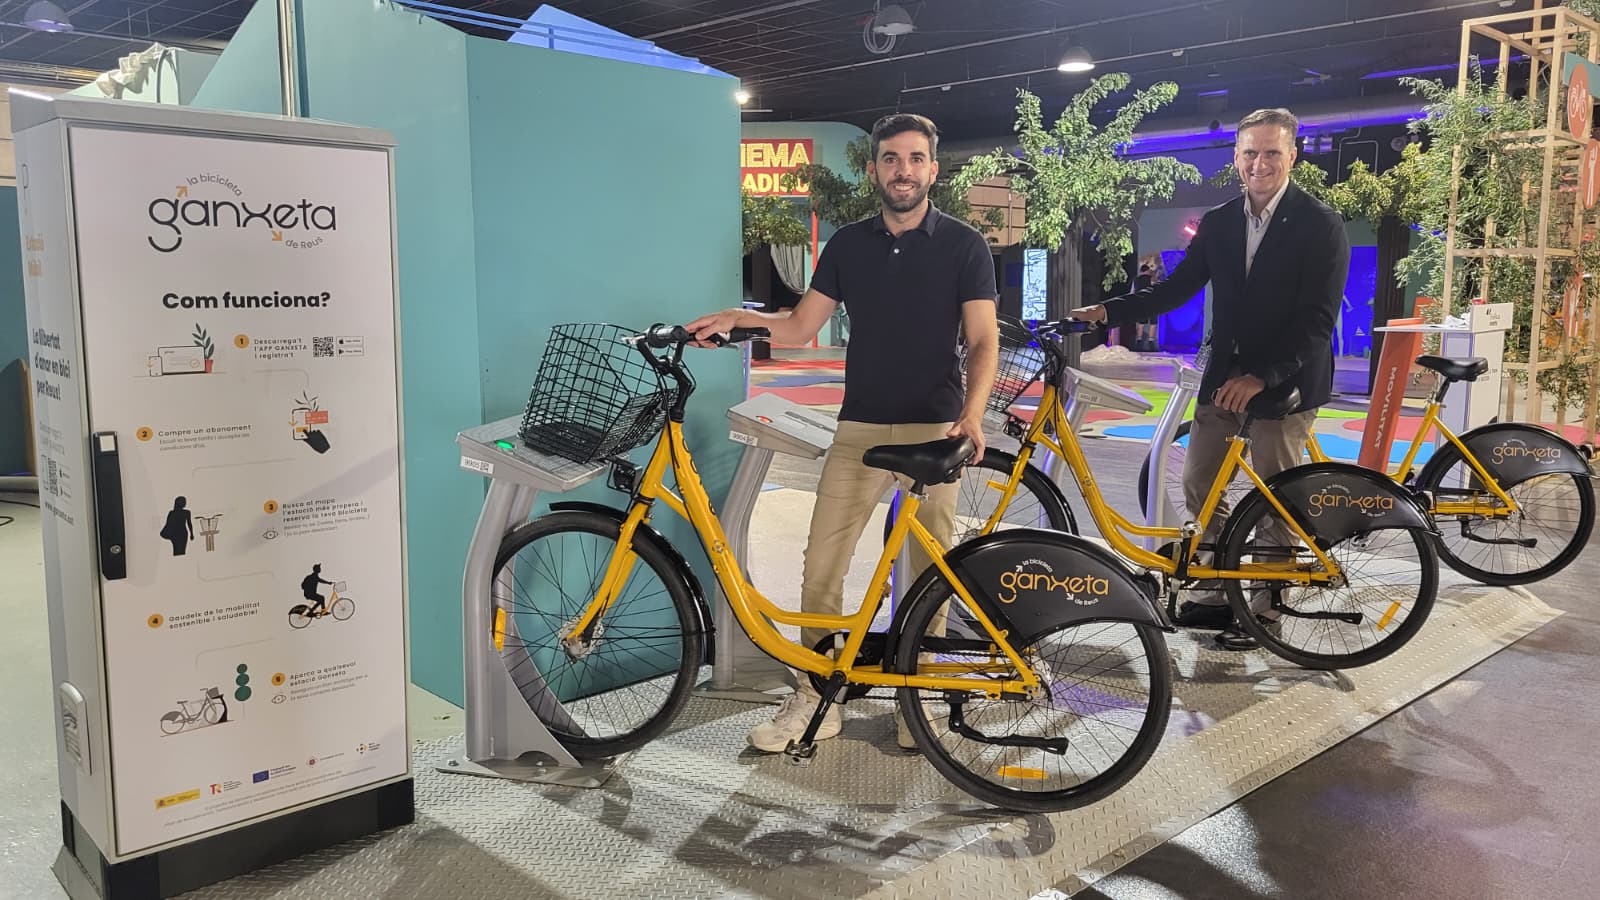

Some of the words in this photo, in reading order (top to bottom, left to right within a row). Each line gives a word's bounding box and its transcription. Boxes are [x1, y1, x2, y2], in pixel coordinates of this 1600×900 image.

[740, 143, 809, 168] EMA
[187, 176, 198, 187] la
[200, 173, 242, 197] bicicleta
[148, 198, 336, 253] ganxeta
[285, 238, 298, 248] de
[300, 236, 323, 249] Reus
[162, 293, 218, 309] Com
[223, 291, 331, 308] funciona?
[1374, 366, 1397, 449] MOVILITAT
[1491, 446, 1561, 465] ganxeta
[1308, 493, 1393, 517] ganxeta
[998, 571, 1109, 604] ganxeta
